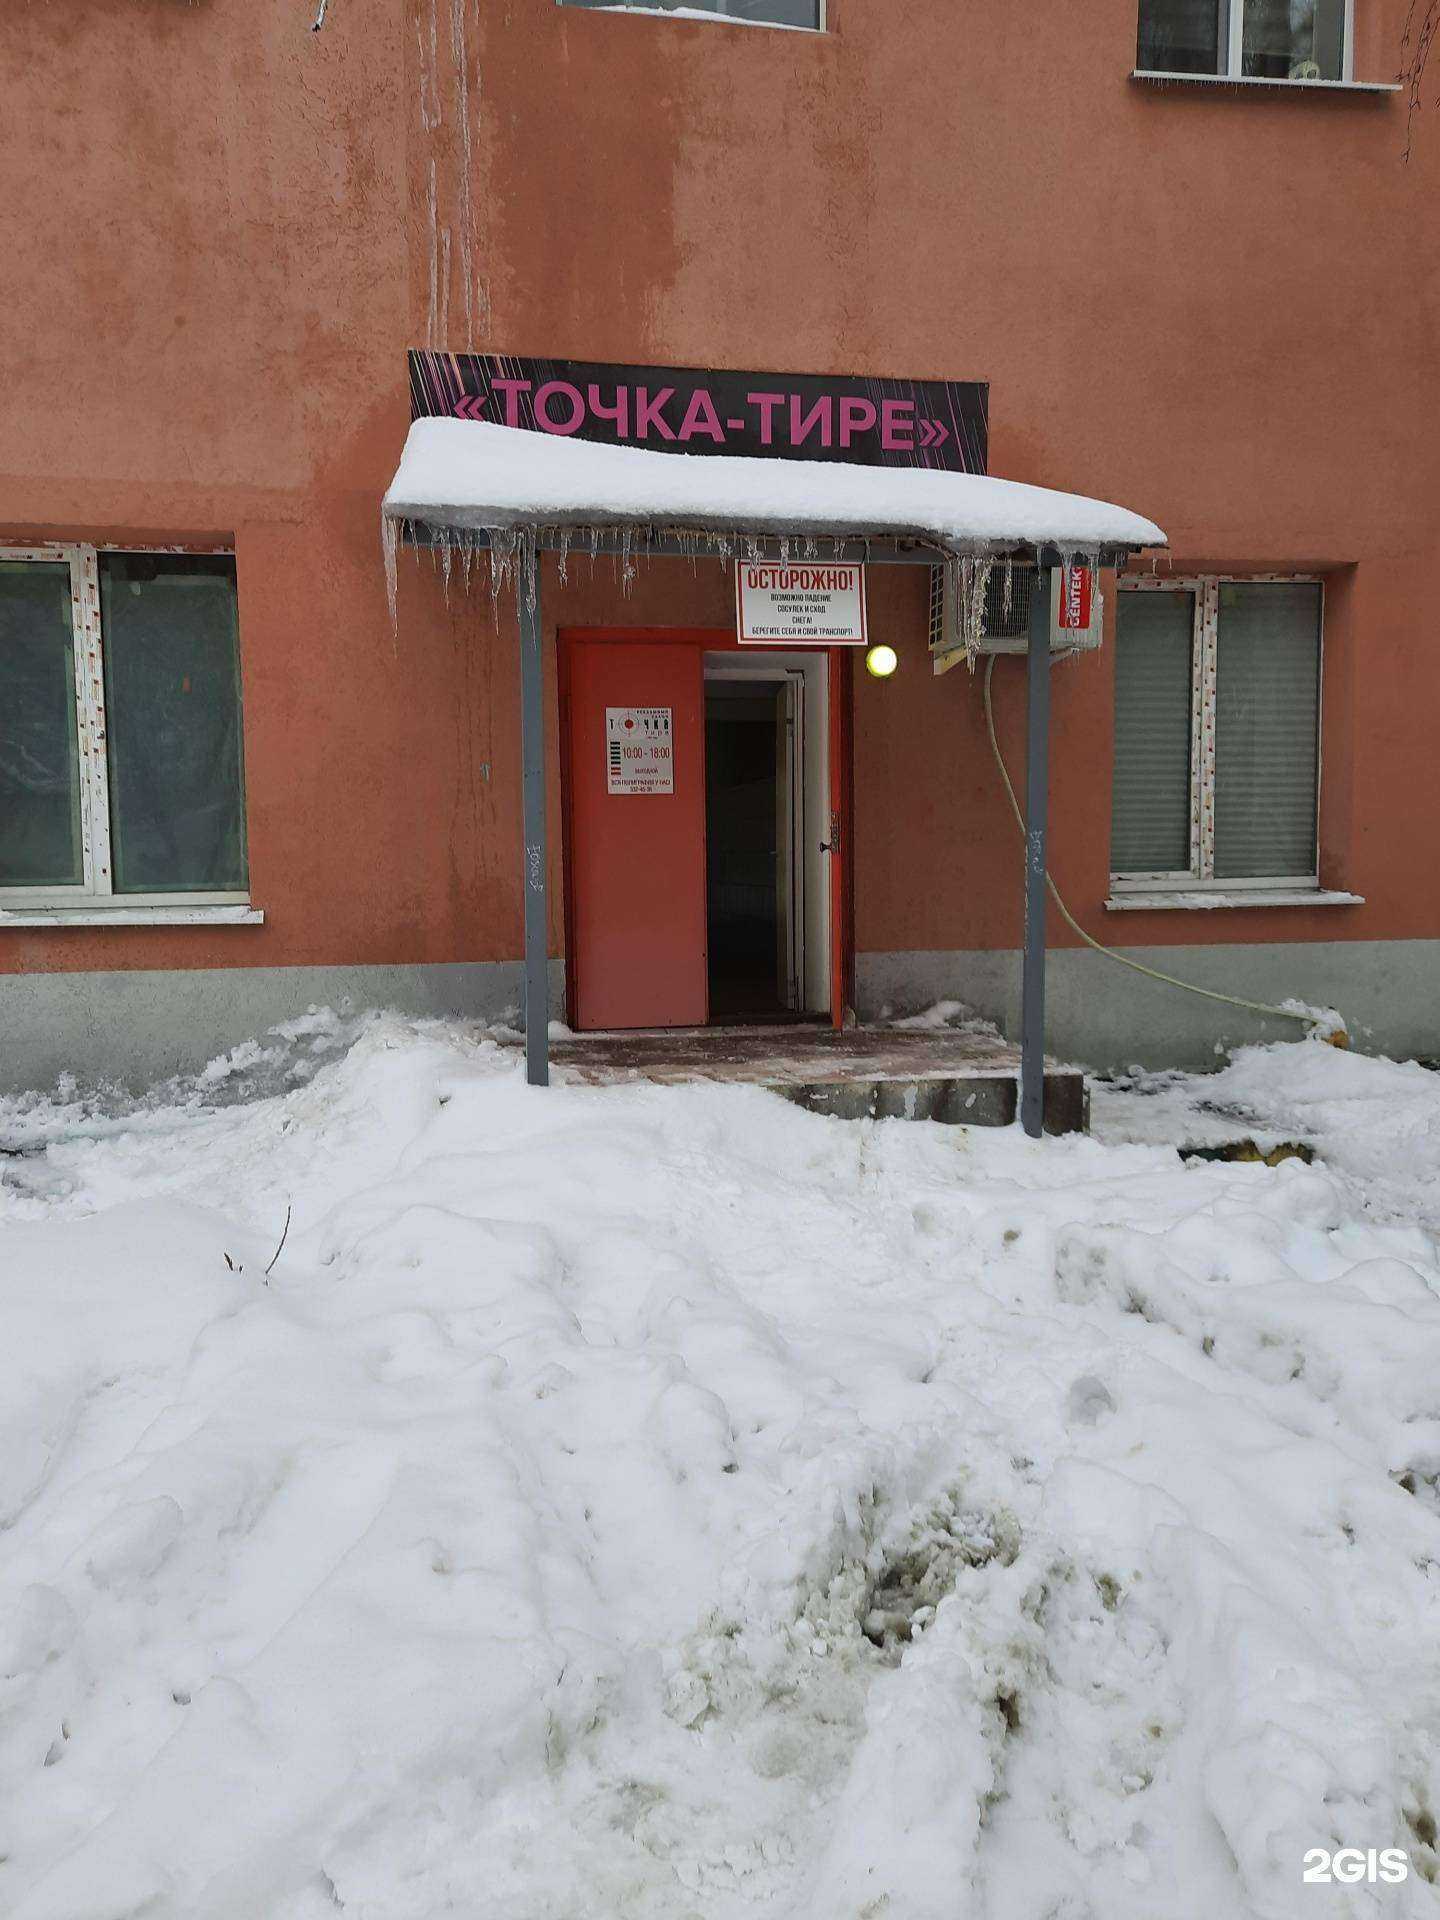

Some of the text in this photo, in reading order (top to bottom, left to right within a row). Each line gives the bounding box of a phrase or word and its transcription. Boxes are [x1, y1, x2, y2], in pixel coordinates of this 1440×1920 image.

[748, 568, 853, 590] ОСТОРОЖНО!
[770, 593, 831, 602] ВОЗМОЖНО ПАДЕНИЕ
[777, 604, 804, 613] СОСУЛЕК
[810, 605, 826, 613] СХОД
[792, 616, 812, 624] СНЕГА!
[752, 626, 780, 635] БЕРЕГИТЕ
[781, 627, 797, 635] СЕБЯ
[803, 626, 818, 635] СВОЙ
[819, 627, 853, 635] ТРАНСПОРТ!
[651, 747, 670, 759] 18:00
